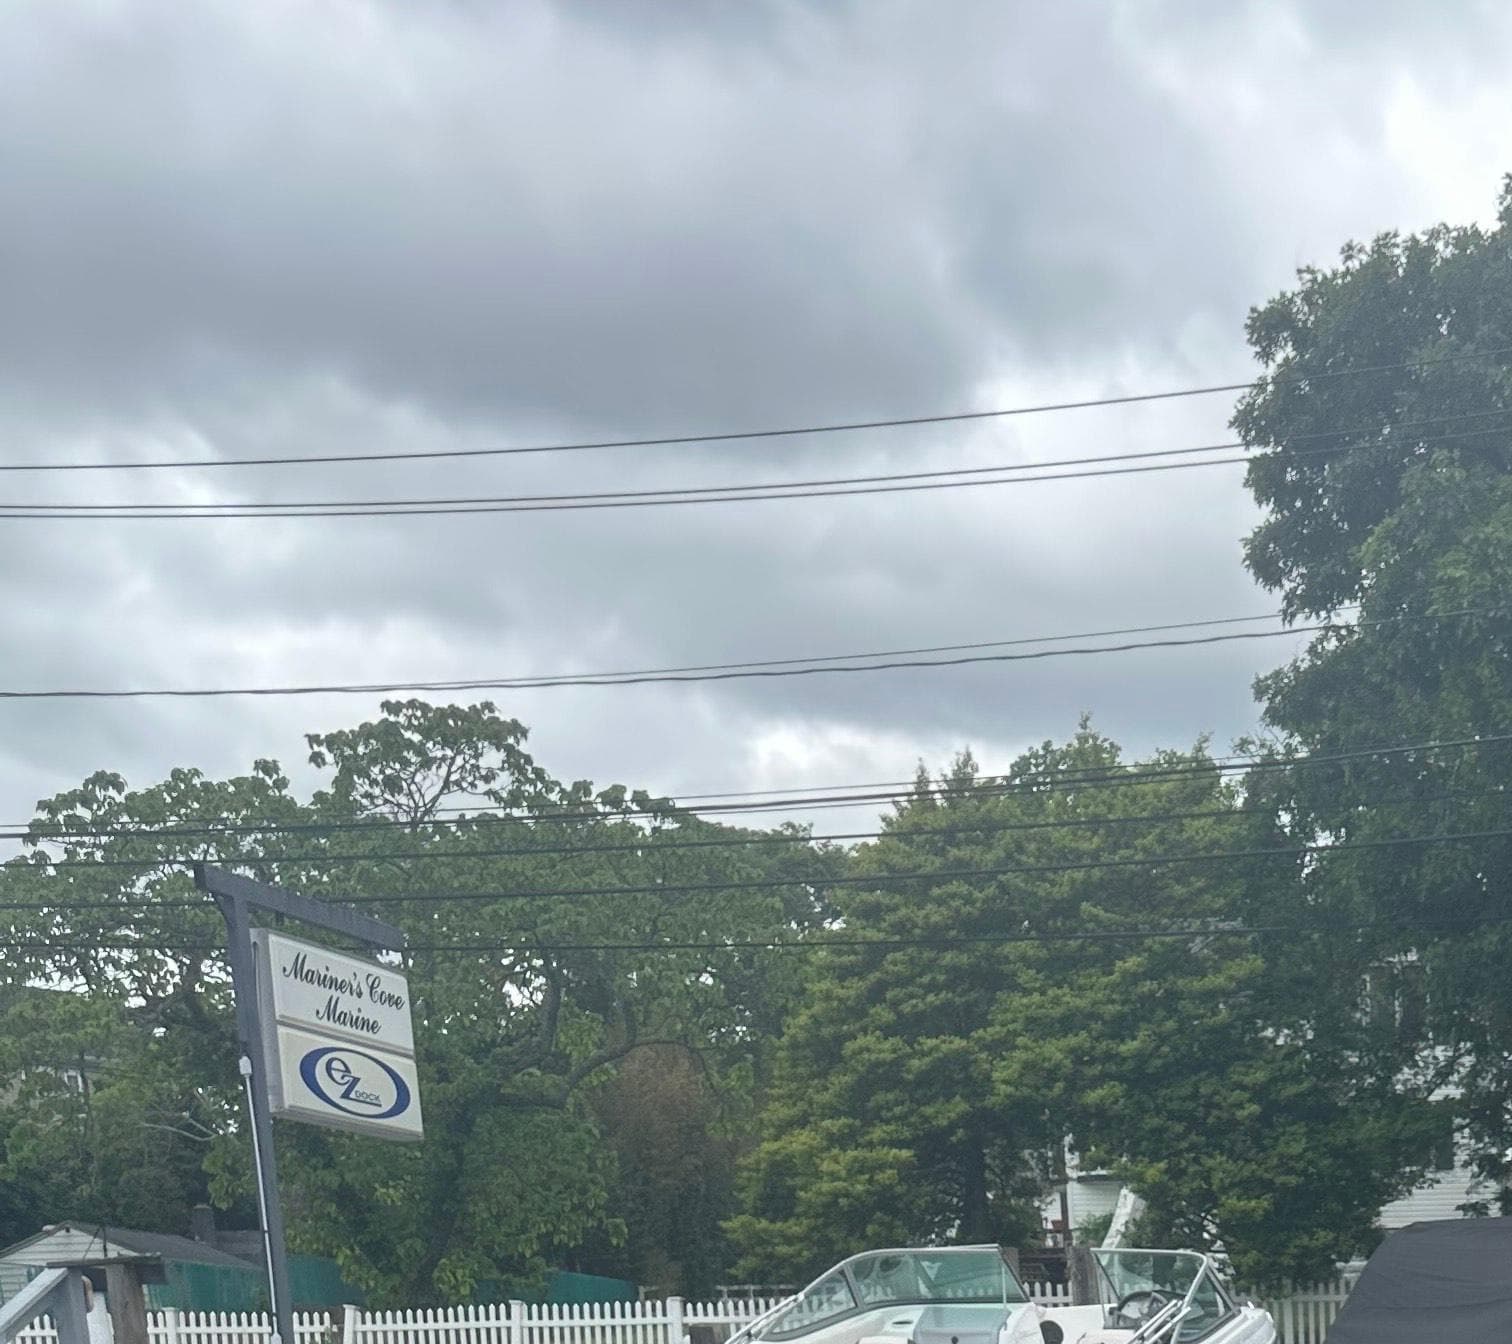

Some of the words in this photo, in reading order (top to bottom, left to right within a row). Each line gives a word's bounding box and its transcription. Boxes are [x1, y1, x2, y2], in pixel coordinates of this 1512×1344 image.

[283, 952, 363, 998] Mariner's
[366, 973, 405, 1010] Cove
[316, 995, 381, 1034] Marine
